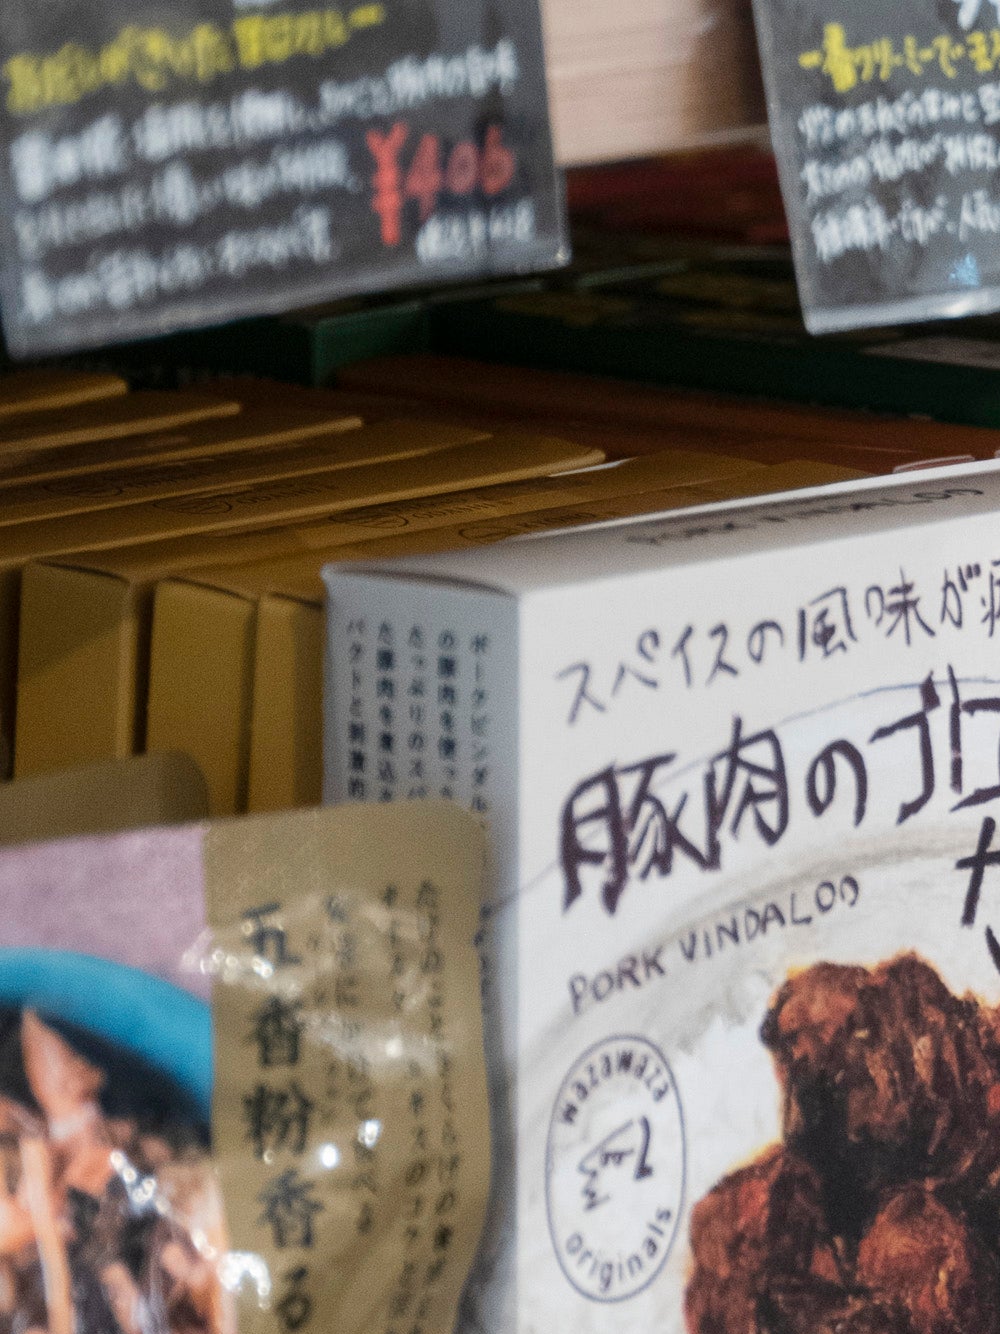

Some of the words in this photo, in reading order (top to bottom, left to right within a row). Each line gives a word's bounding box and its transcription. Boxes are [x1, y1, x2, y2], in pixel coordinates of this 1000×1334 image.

[366, 122, 516, 246] ¥406
[567, 949, 664, 1016] PORK
[679, 873, 862, 963] VINDALOO
[565, 1206, 672, 1294] originals
